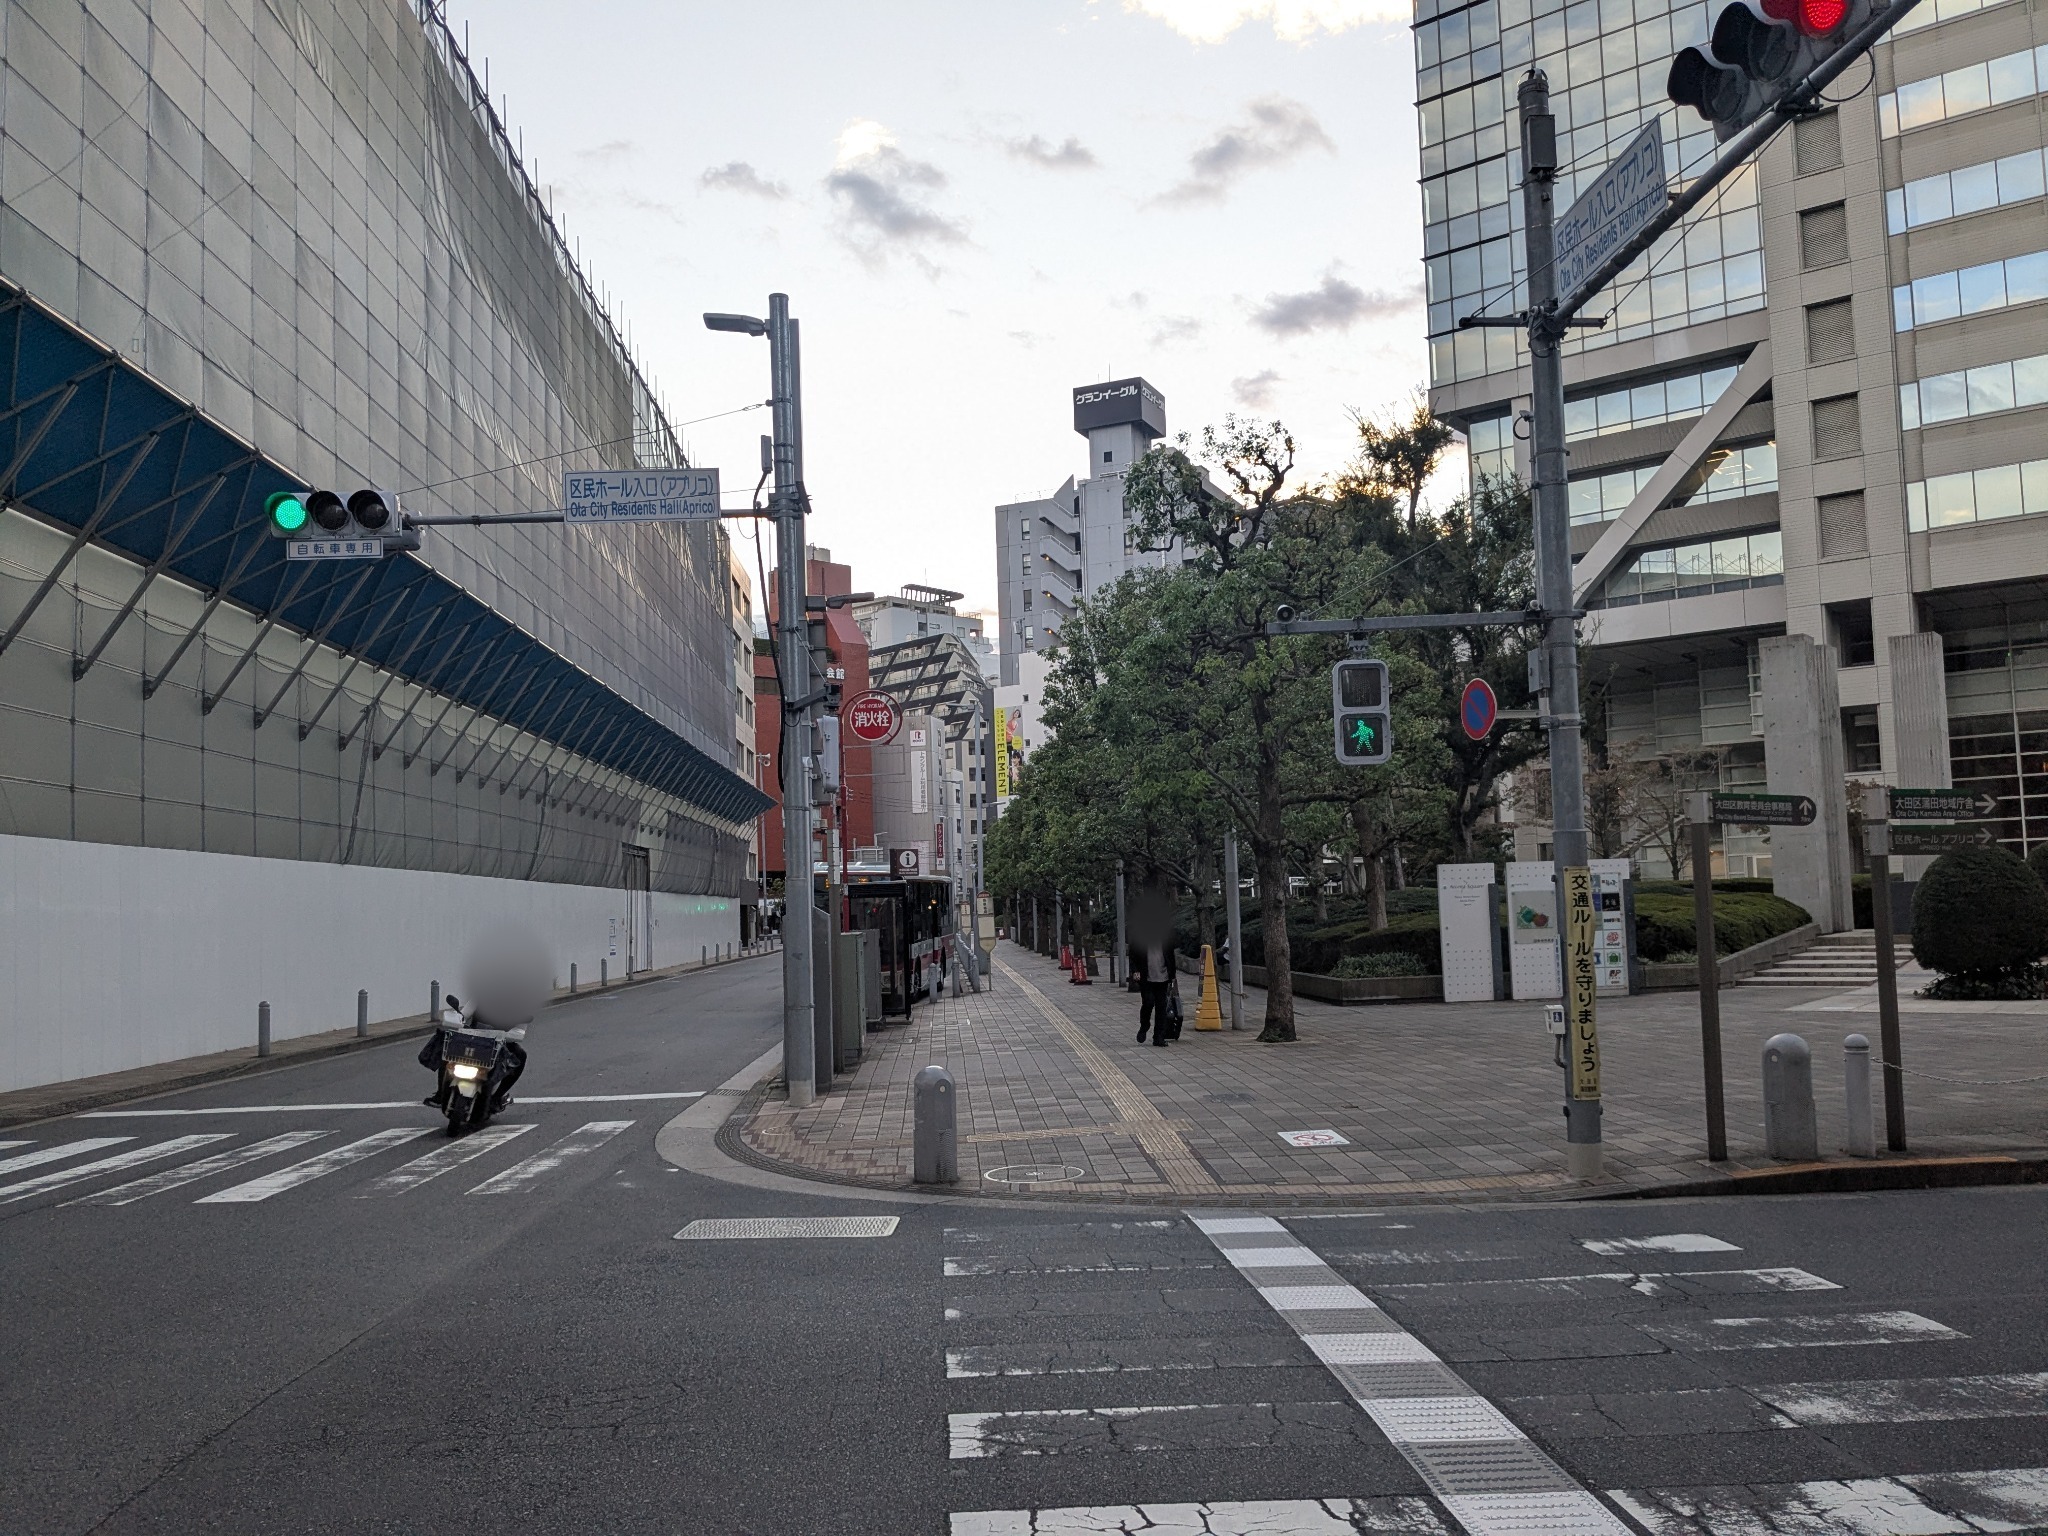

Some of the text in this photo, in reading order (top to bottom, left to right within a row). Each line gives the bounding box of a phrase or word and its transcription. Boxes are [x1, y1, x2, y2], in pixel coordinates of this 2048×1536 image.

[1560, 266, 1571, 292] Ota
[1571, 250, 1585, 279] City
[1585, 223, 1618, 263] Residents
[1076, 385, 1139, 405] グランイーグル
[570, 475, 713, 499] 区民ホール入口(アプリコ)
[570, 501, 587, 517] Ota
[590, 500, 609, 519] City
[611, 500, 657, 516] Residents
[297, 543, 373, 555] 自転車専用
[826, 667, 845, 680] 会館
[855, 711, 890, 728] 消火栓
[997, 743, 1007, 795] ELEMENT
[1571, 875, 1595, 1072] 交通ルールを守りましょう
